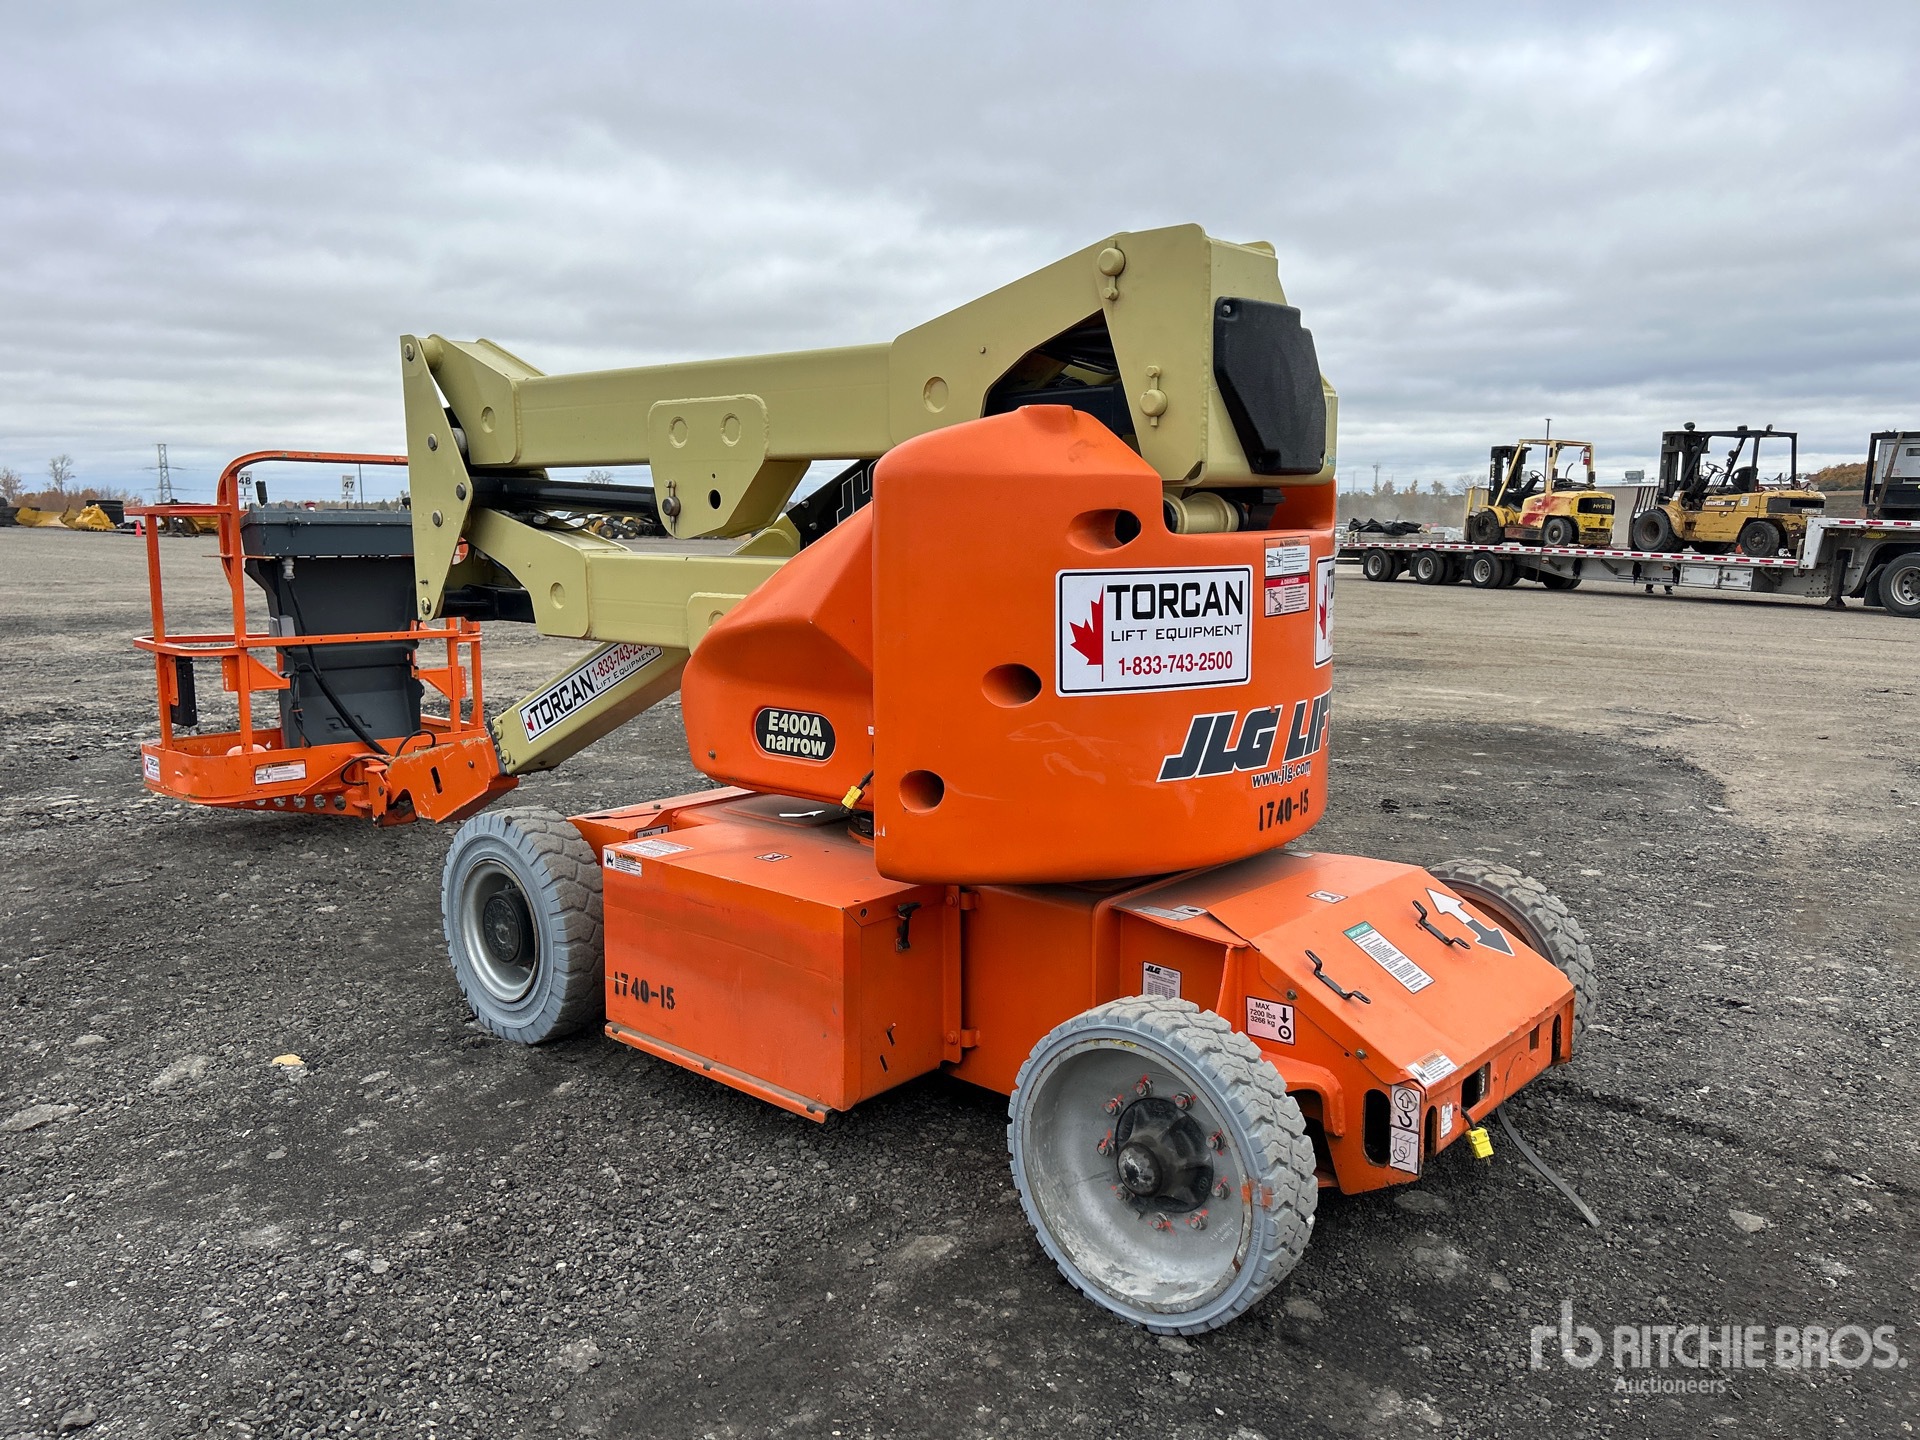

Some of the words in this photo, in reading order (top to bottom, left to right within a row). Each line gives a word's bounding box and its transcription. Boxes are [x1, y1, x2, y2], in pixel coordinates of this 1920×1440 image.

[239, 477, 251, 485] 48
[344, 481, 354, 489] 47
[1107, 581, 1243, 620] TORCAN
[1111, 629, 1147, 641] LIFT
[1156, 624, 1242, 641] EQUIPMENT
[591, 643, 648, 681] 1-833-743-2
[595, 676, 611, 691] LIFT
[612, 647, 656, 679] EQUIPMENT
[1118, 651, 1233, 676] 1-833-743-2500
[529, 670, 595, 730] TORCAN
[768, 711, 822, 738] E400A
[765, 733, 826, 757] narrow
[1156, 704, 1283, 782] JLG
[1251, 760, 1311, 788] www.jlg.com
[1259, 788, 1309, 831] 1740-15
[1145, 965, 1161, 974] JLG
[614, 971, 676, 1010] 1740-15
[1250, 1008, 1265, 1017] 7200
[1266, 1012, 1276, 1020] lbs
[1255, 1001, 1270, 1011] MAX
[1267, 1019, 1276, 1027] kg
